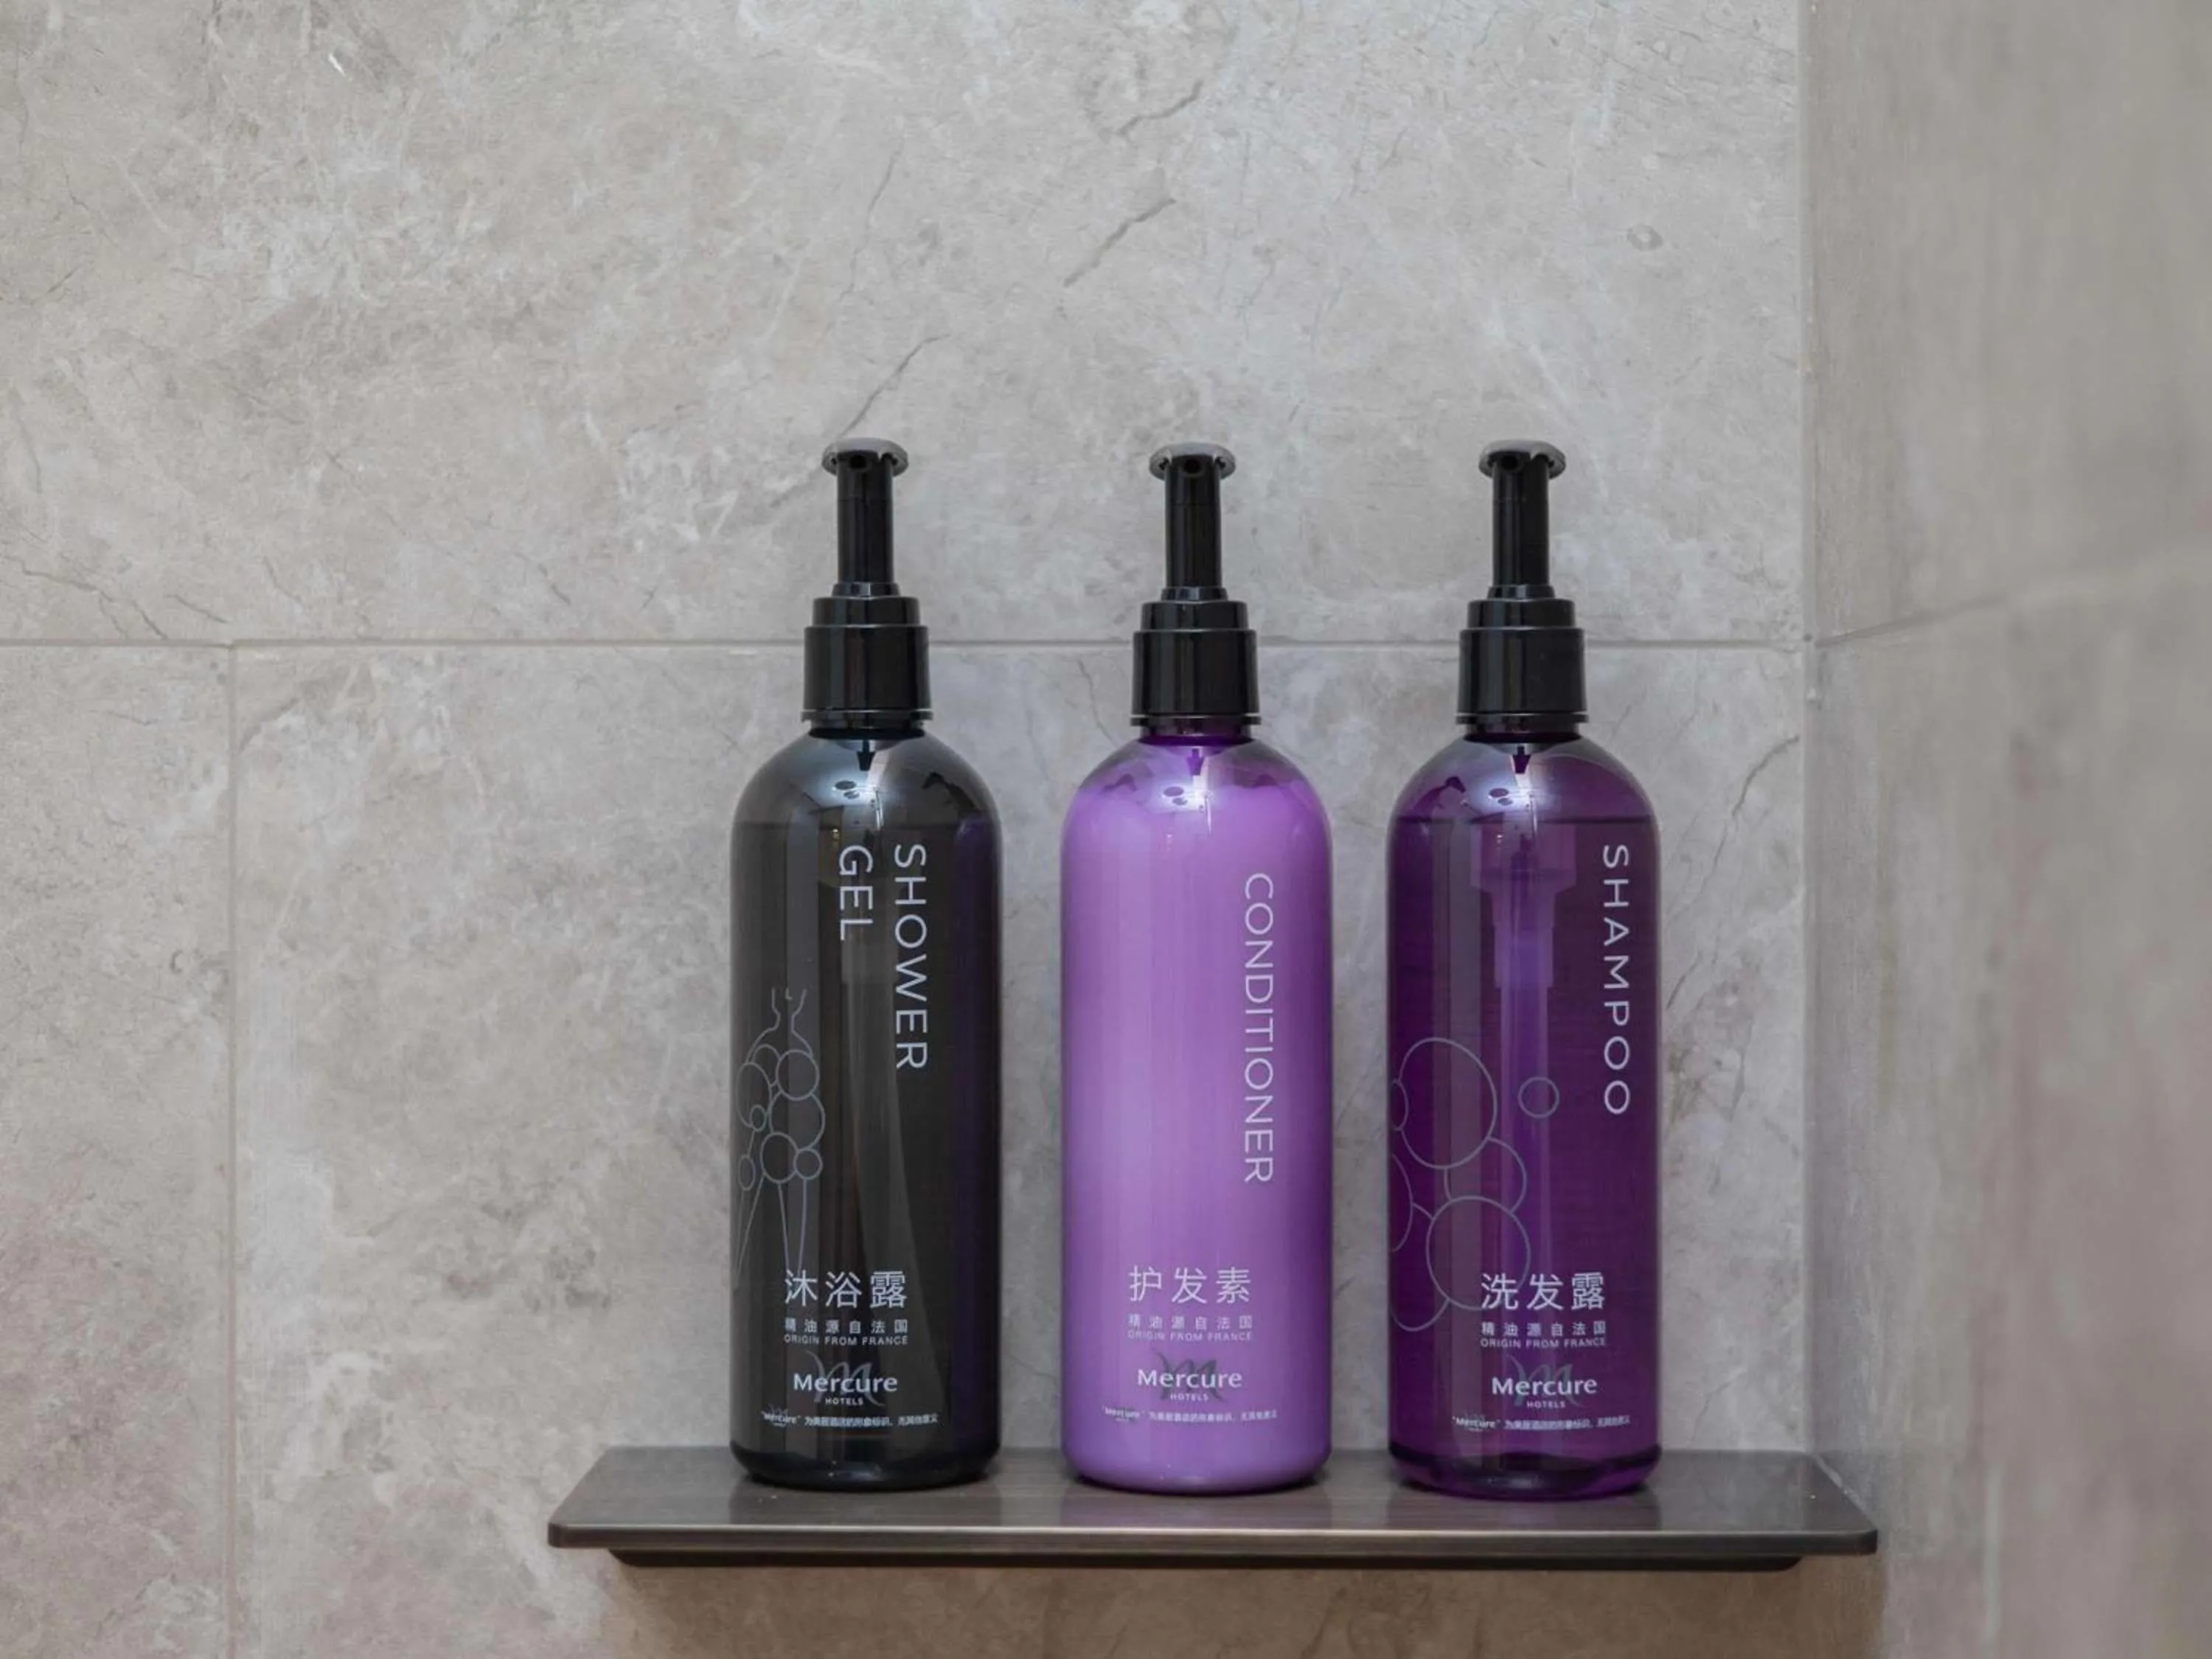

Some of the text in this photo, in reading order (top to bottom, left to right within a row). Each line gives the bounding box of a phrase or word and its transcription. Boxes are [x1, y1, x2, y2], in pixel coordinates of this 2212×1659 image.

[839, 845, 873, 941] GEL
[894, 844, 928, 1068] SHOWER
[1603, 844, 1630, 1115] SHAMPOO
[1244, 873, 1273, 1183] CONDITIONER
[785, 1269, 907, 1308] 沐浴露
[1128, 1265, 1251, 1304] 护发素
[1481, 1272, 1605, 1311] 洗发露
[785, 1318, 908, 1335] 精油源自法国
[1127, 1330, 1252, 1341] ORIGIN FROM FRANCE
[1481, 1321, 1606, 1337] 精油源自法国
[784, 1334, 908, 1346] ORIGIN FROM FRANCE
[1481, 1338, 1605, 1349] ORIGIN FROM FRANCE
[793, 1373, 897, 1393] Mercure
[1137, 1369, 1242, 1388] Mercure
[1491, 1377, 1597, 1396] Mercure
[825, 1397, 863, 1405] HOTELS
[1170, 1392, 1208, 1402] HOTELS
[1527, 1400, 1565, 1408] HOTELS
